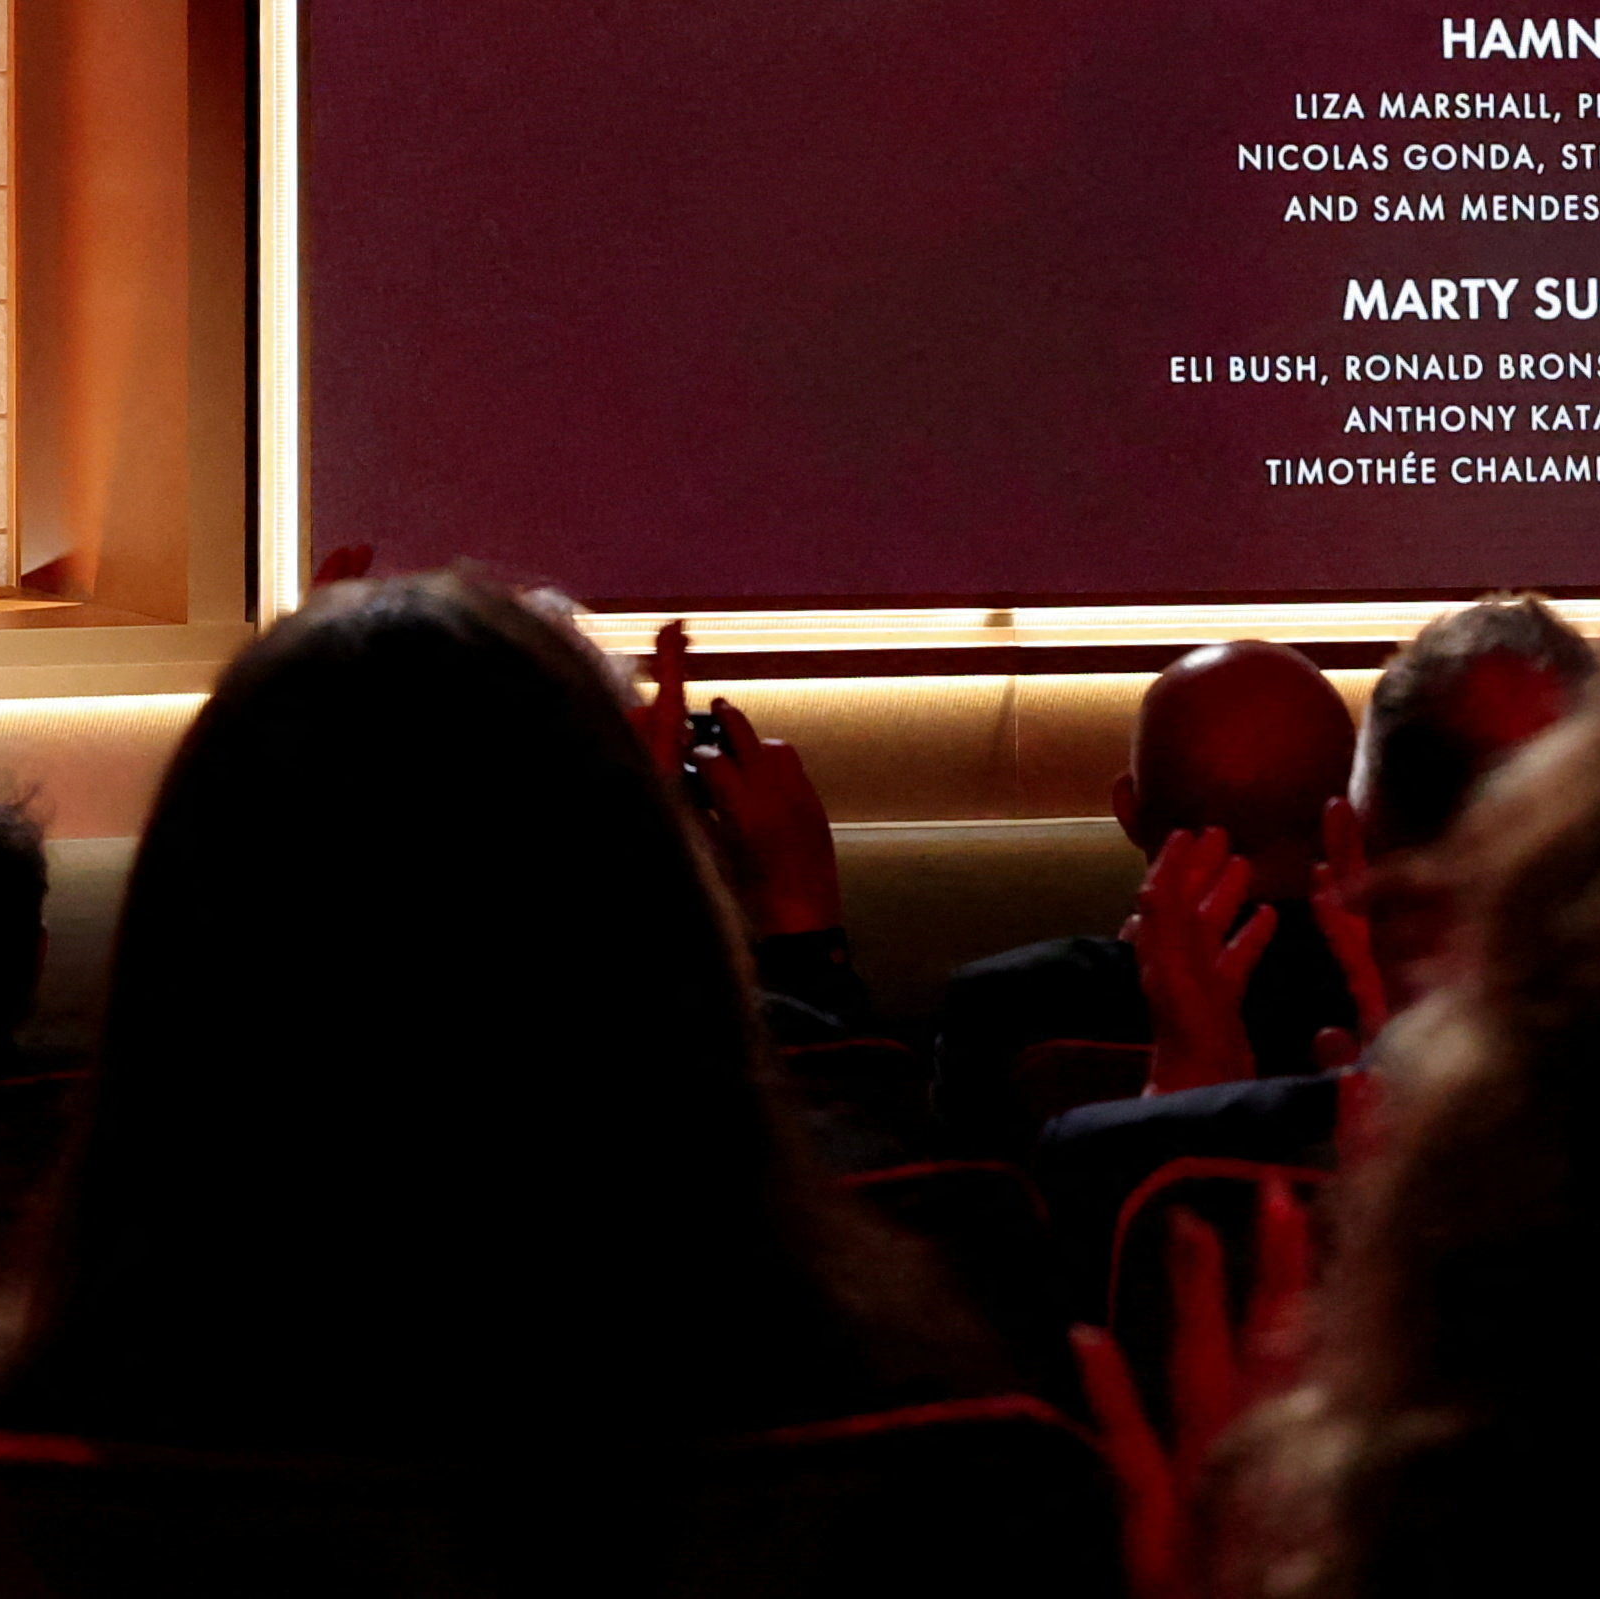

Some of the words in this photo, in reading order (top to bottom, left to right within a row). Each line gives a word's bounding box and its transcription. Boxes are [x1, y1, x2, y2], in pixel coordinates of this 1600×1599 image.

[1295, 93, 1365, 120] LIZA
[1379, 92, 1561, 124] MARSHALL,
[1238, 143, 1389, 171] NICOLAS
[1403, 143, 1545, 175] GONDA,
[1284, 195, 1358, 222] AND
[1373, 194, 1445, 222] SAM
[1343, 278, 1519, 321] MARTY
[1170, 356, 1213, 383] ELI
[1229, 355, 1329, 386] BUSH,
[1345, 353, 1483, 382] RONALD
[1343, 405, 1517, 433] ANTHONY
[1265, 451, 1436, 486] TIMOTHÉE
